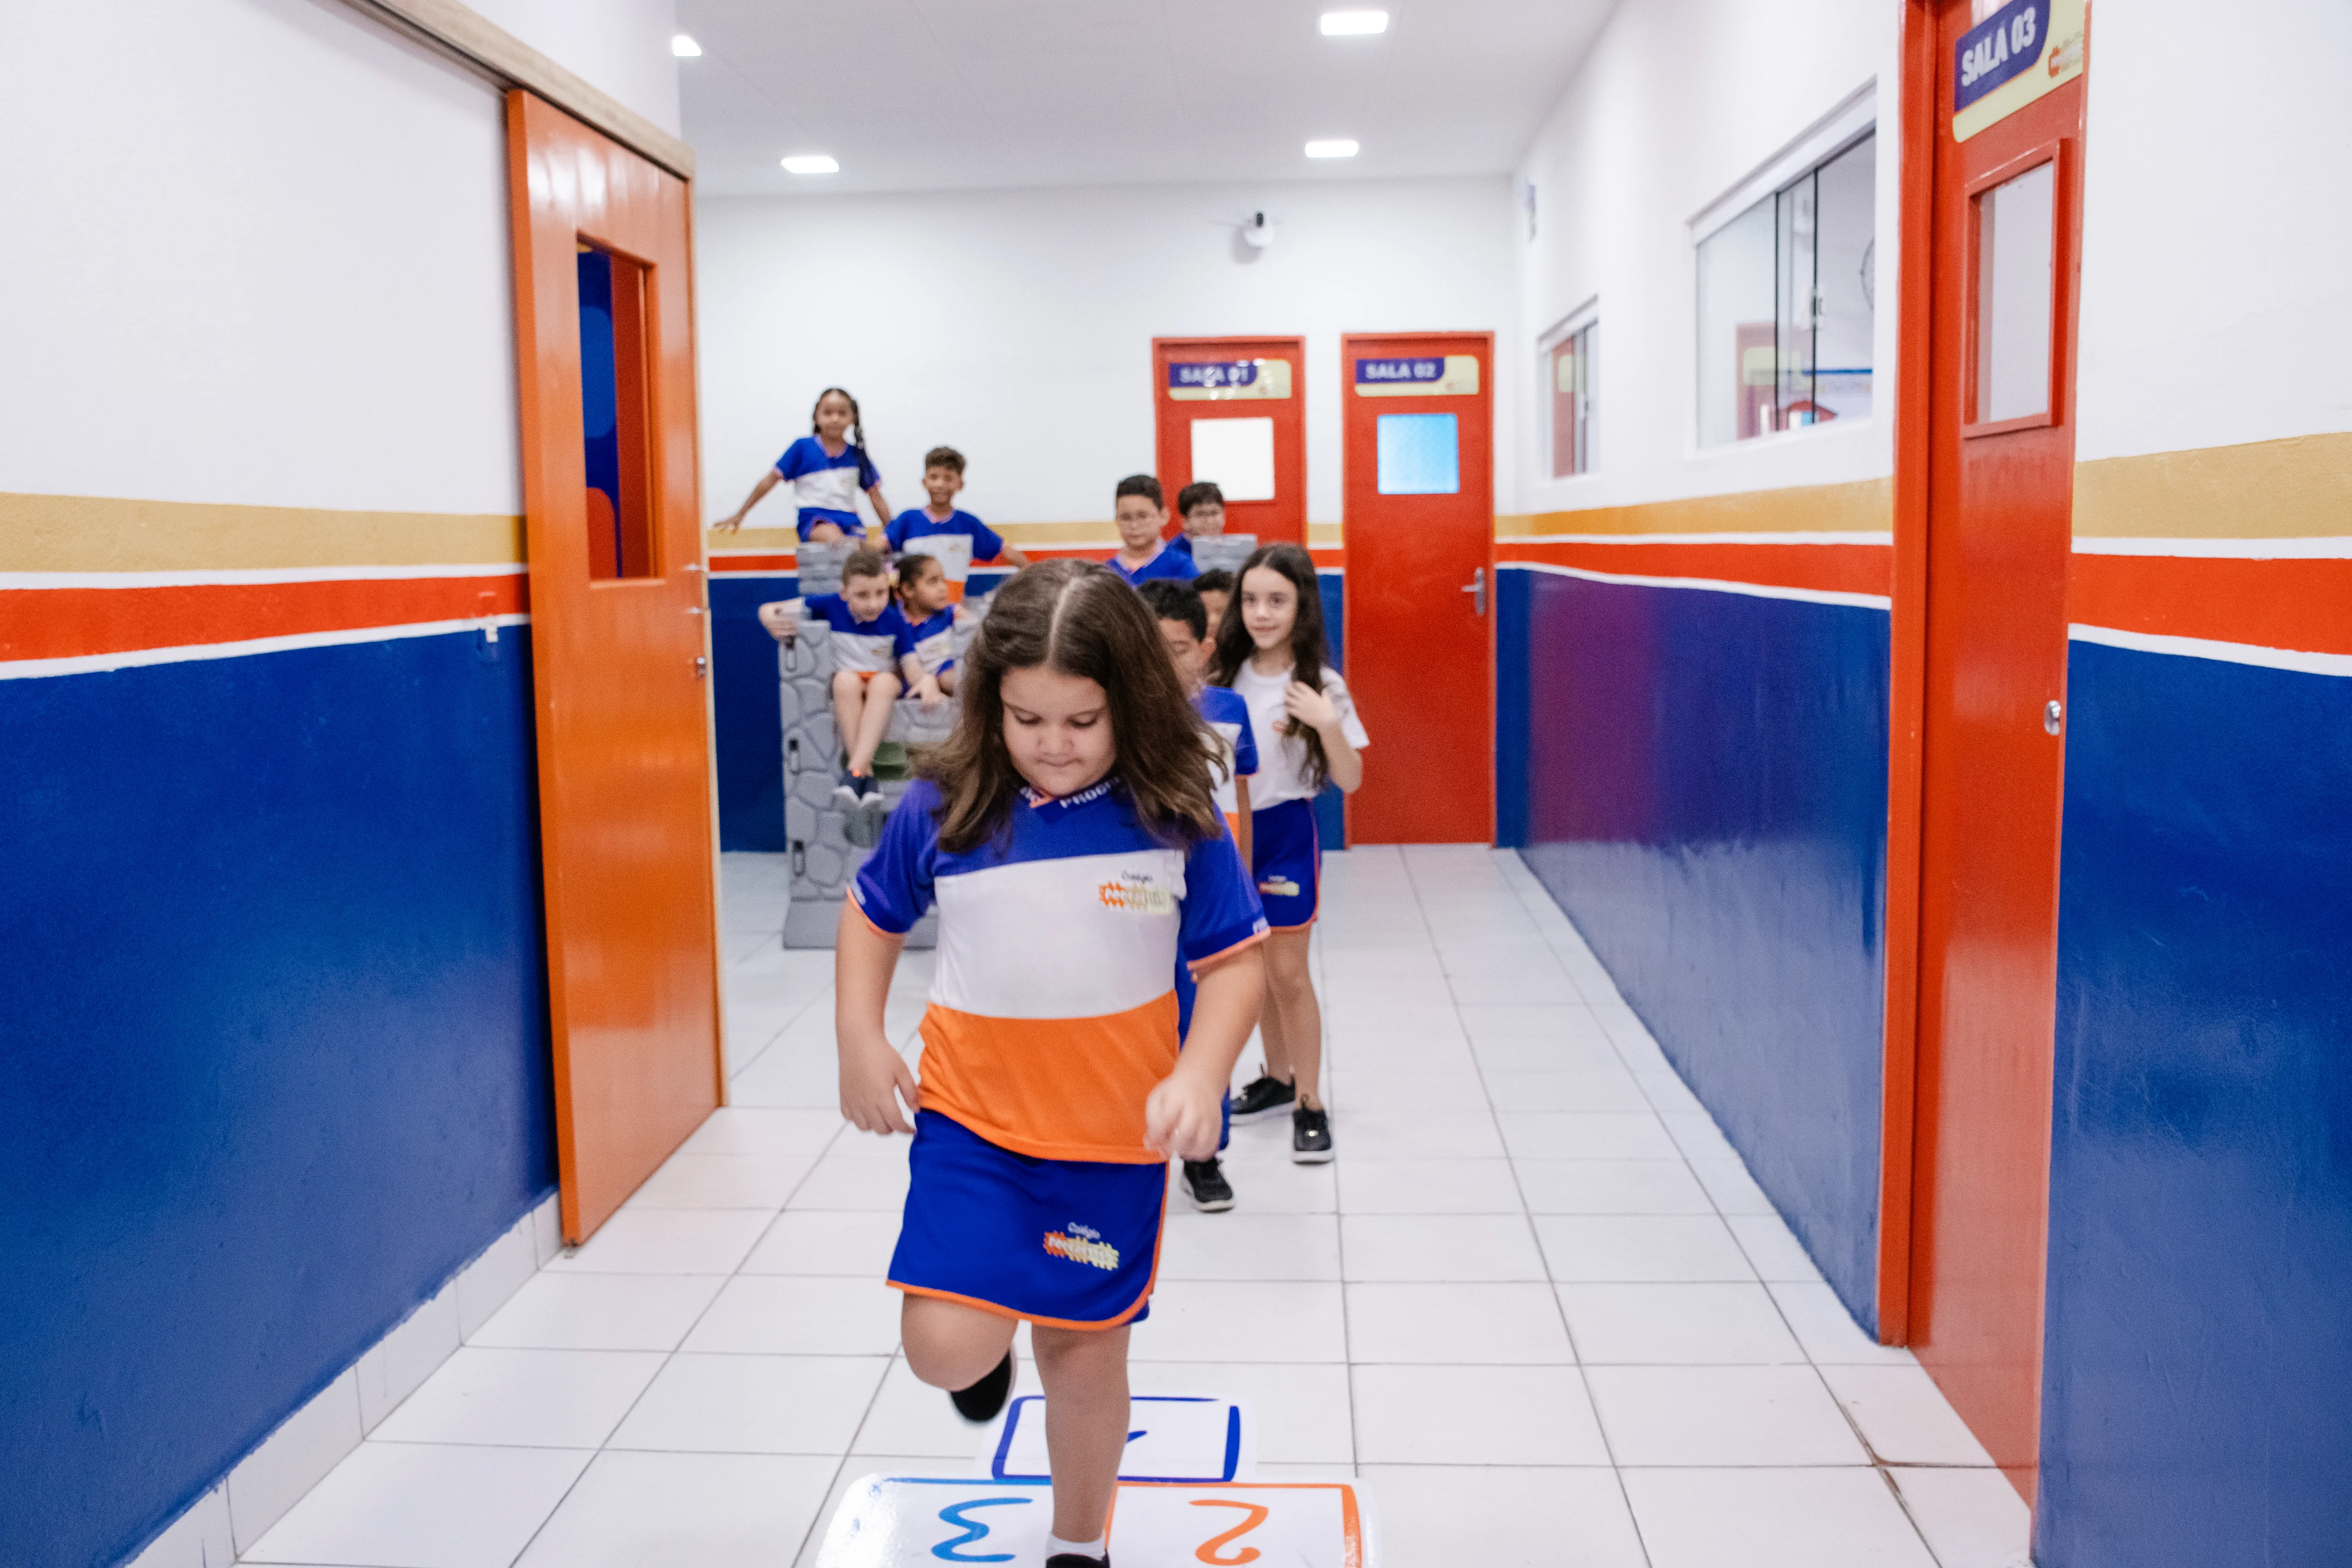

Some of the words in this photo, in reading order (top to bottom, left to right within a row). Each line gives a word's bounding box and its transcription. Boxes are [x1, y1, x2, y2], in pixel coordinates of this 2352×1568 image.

[1961, 26, 2009, 87] SALA
[2011, 7, 2036, 54] 03
[1179, 366, 1225, 383] SALA
[1227, 366, 1249, 382] 01
[1365, 362, 1411, 379] SALA
[1413, 362, 1436, 378] 02
[931, 1497, 1032, 1563] 3
[1188, 1499, 1269, 1565] 2
